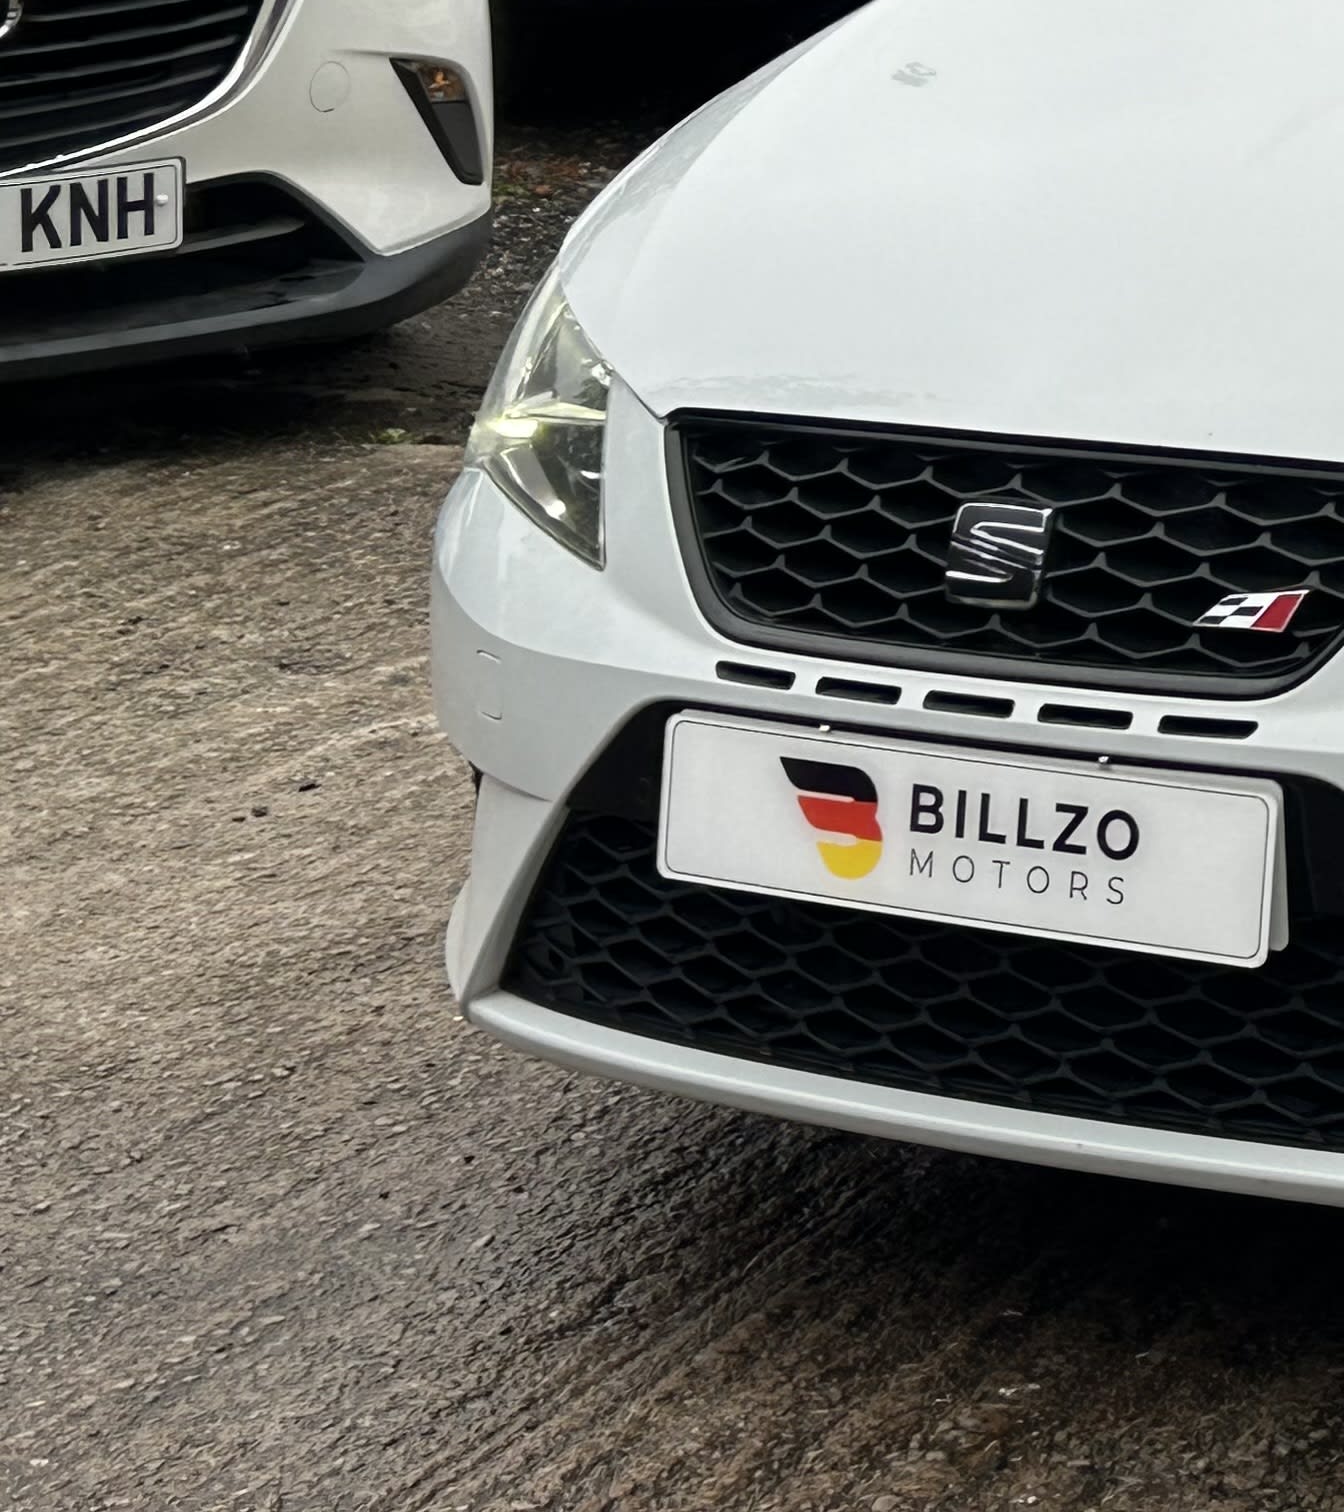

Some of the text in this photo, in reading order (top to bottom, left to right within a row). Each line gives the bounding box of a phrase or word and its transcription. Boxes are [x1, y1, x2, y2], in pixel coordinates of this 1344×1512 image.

[20, 172, 154, 253] KNH
[909, 783, 1140, 861] BILLZO
[909, 848, 1124, 905] MOTORS
